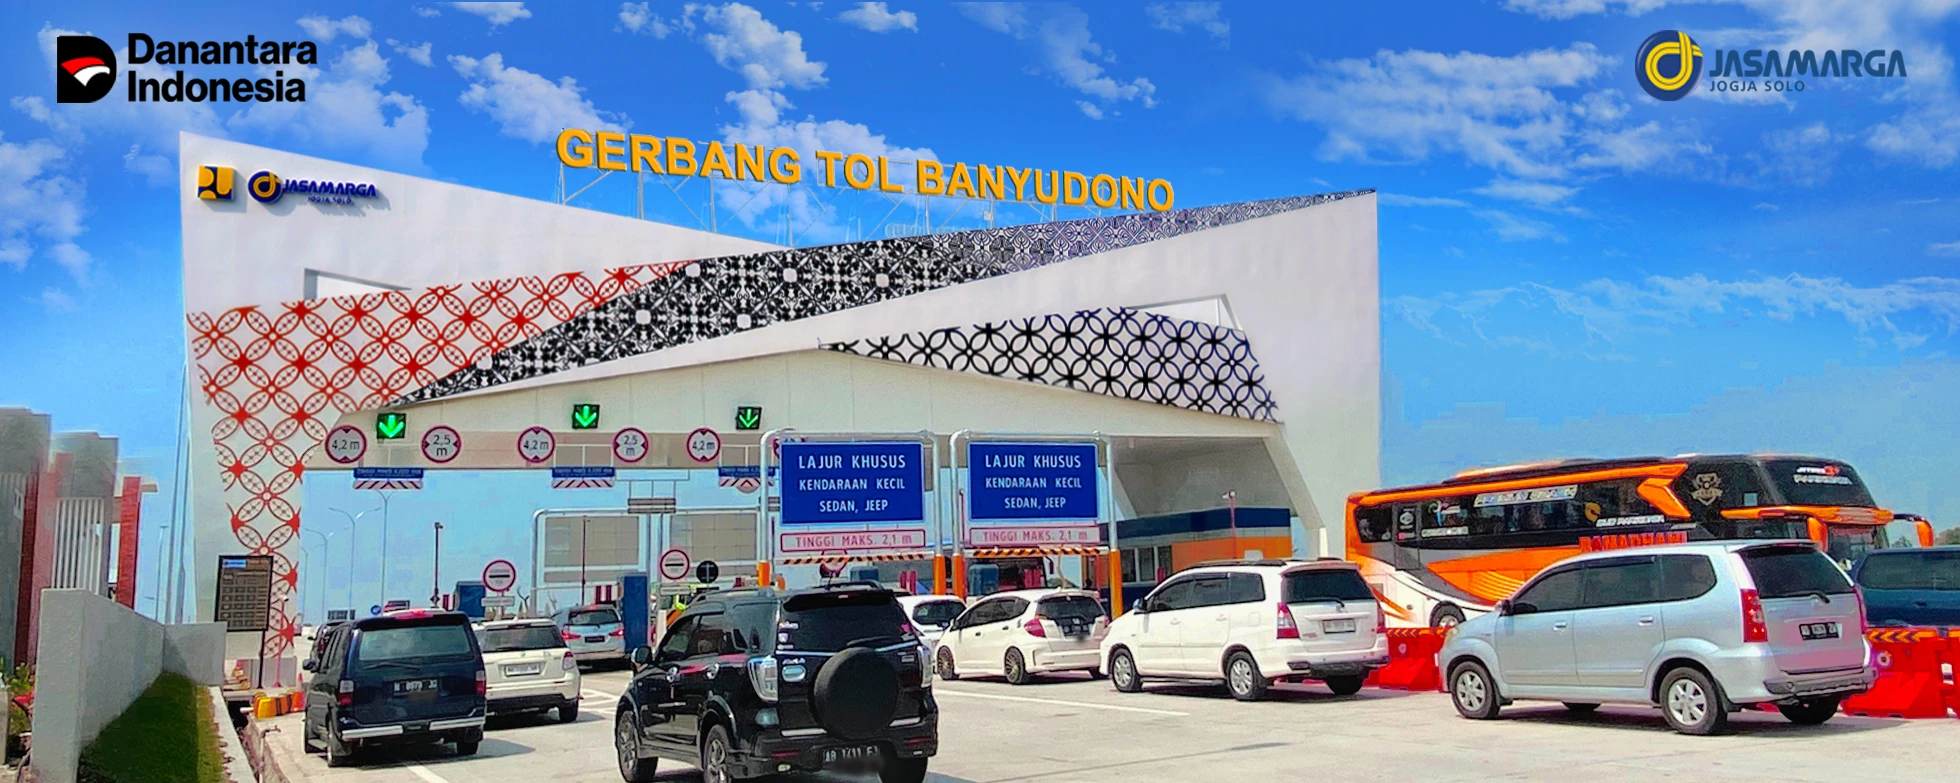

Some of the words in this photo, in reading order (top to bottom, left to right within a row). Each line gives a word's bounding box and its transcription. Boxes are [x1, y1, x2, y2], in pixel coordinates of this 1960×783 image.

[556, 128, 801, 184] GERBANG
[816, 150, 904, 193] TOL
[916, 159, 1175, 212] BANYUDONO
[282, 179, 377, 197] JASAMARGA
[331, 439, 348, 450] 4,2
[350, 439, 361, 450] m
[433, 434, 451, 446] 2,5
[523, 439, 539, 451] 4,2
[540, 440, 549, 450] m
[623, 435, 638, 446] 2,5
[692, 440, 706, 452] 4,2
[706, 442, 715, 450] m
[436, 447, 448, 457] m
[626, 447, 635, 456] m
[798, 455, 843, 470] LAJUR
[851, 454, 906, 469] KHUSUS
[985, 454, 1026, 468] LAJUR
[1033, 454, 1082, 469] KHUSUS
[799, 478, 868, 491] KENDARAAN
[876, 477, 906, 490] KECIL
[985, 477, 1047, 489] KENDARAAN
[1055, 477, 1082, 489] KECIL
[819, 500, 859, 514] SEDAN,
[864, 499, 889, 512] JEEP
[1004, 497, 1042, 510] SEDAN,
[1044, 497, 1067, 509] JEEP
[795, 536, 836, 549] TINGGI
[841, 534, 878, 547] MAKS.
[882, 533, 897, 546] 2,1
[901, 534, 913, 544] m
[983, 531, 1018, 543] TINGGI
[1022, 531, 1056, 542] MAKS.
[1078, 532, 1088, 541] m
